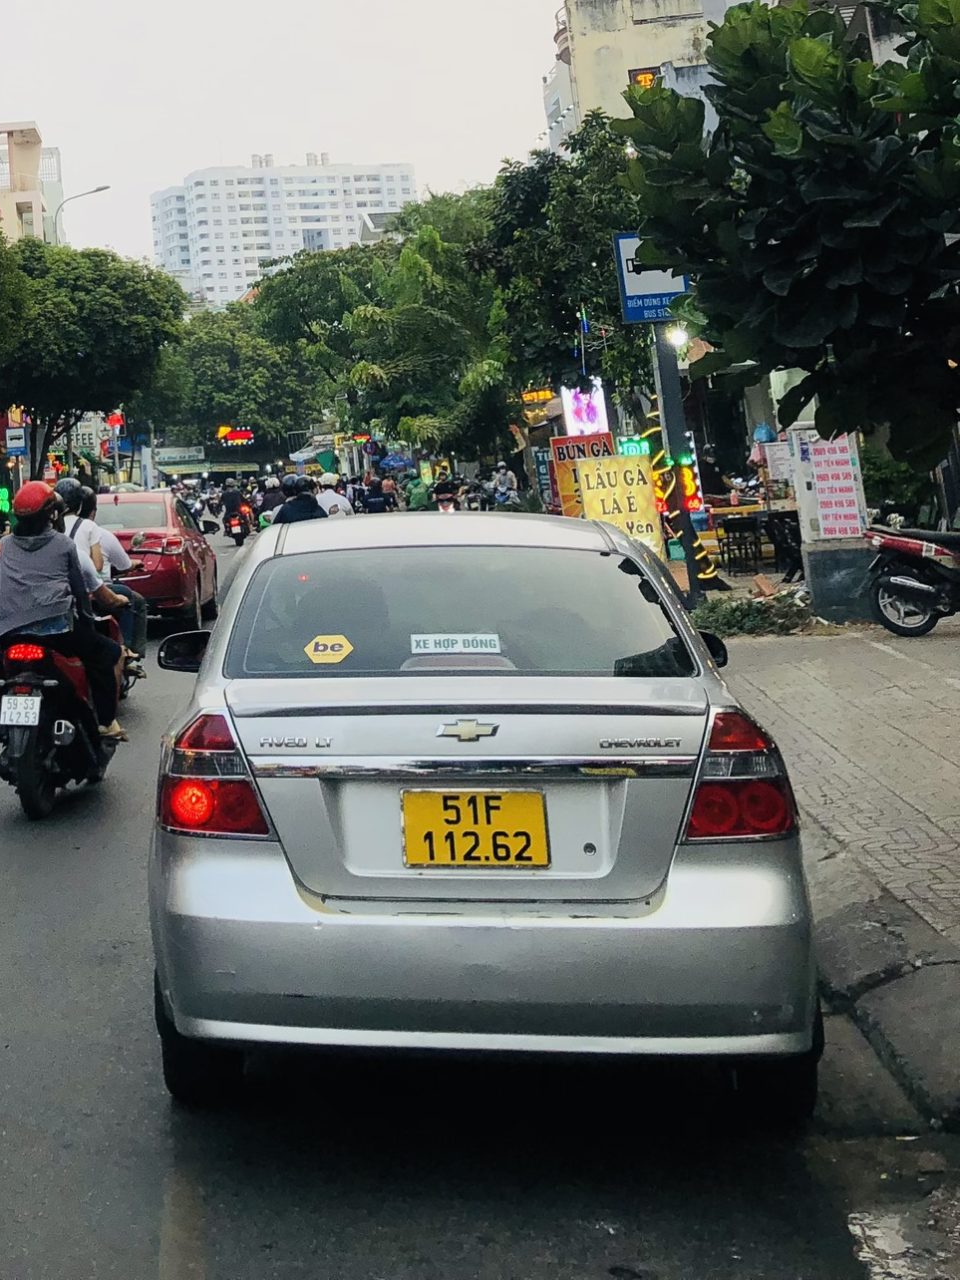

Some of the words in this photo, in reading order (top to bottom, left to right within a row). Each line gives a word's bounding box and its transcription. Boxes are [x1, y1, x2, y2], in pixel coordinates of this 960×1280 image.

[643, 309, 657, 318] BUS
[657, 308, 671, 317] ST
[556, 440, 587, 461] BÚN
[591, 436, 613, 458] GÀ
[584, 463, 618, 490] LẨU
[623, 464, 648, 486] GÀ
[600, 492, 620, 515] LÁ
[628, 491, 638, 512] É
[625, 519, 654, 535] Yên
[313, 641, 344, 653] be
[414, 639, 430, 649] XE
[434, 637, 458, 651] HỢP
[260, 737, 307, 748] AVEO
[315, 737, 333, 748] LT
[599, 737, 682, 749] CHEVROLET
[442, 795, 502, 825] 51F
[423, 830, 533, 861] 112.62
